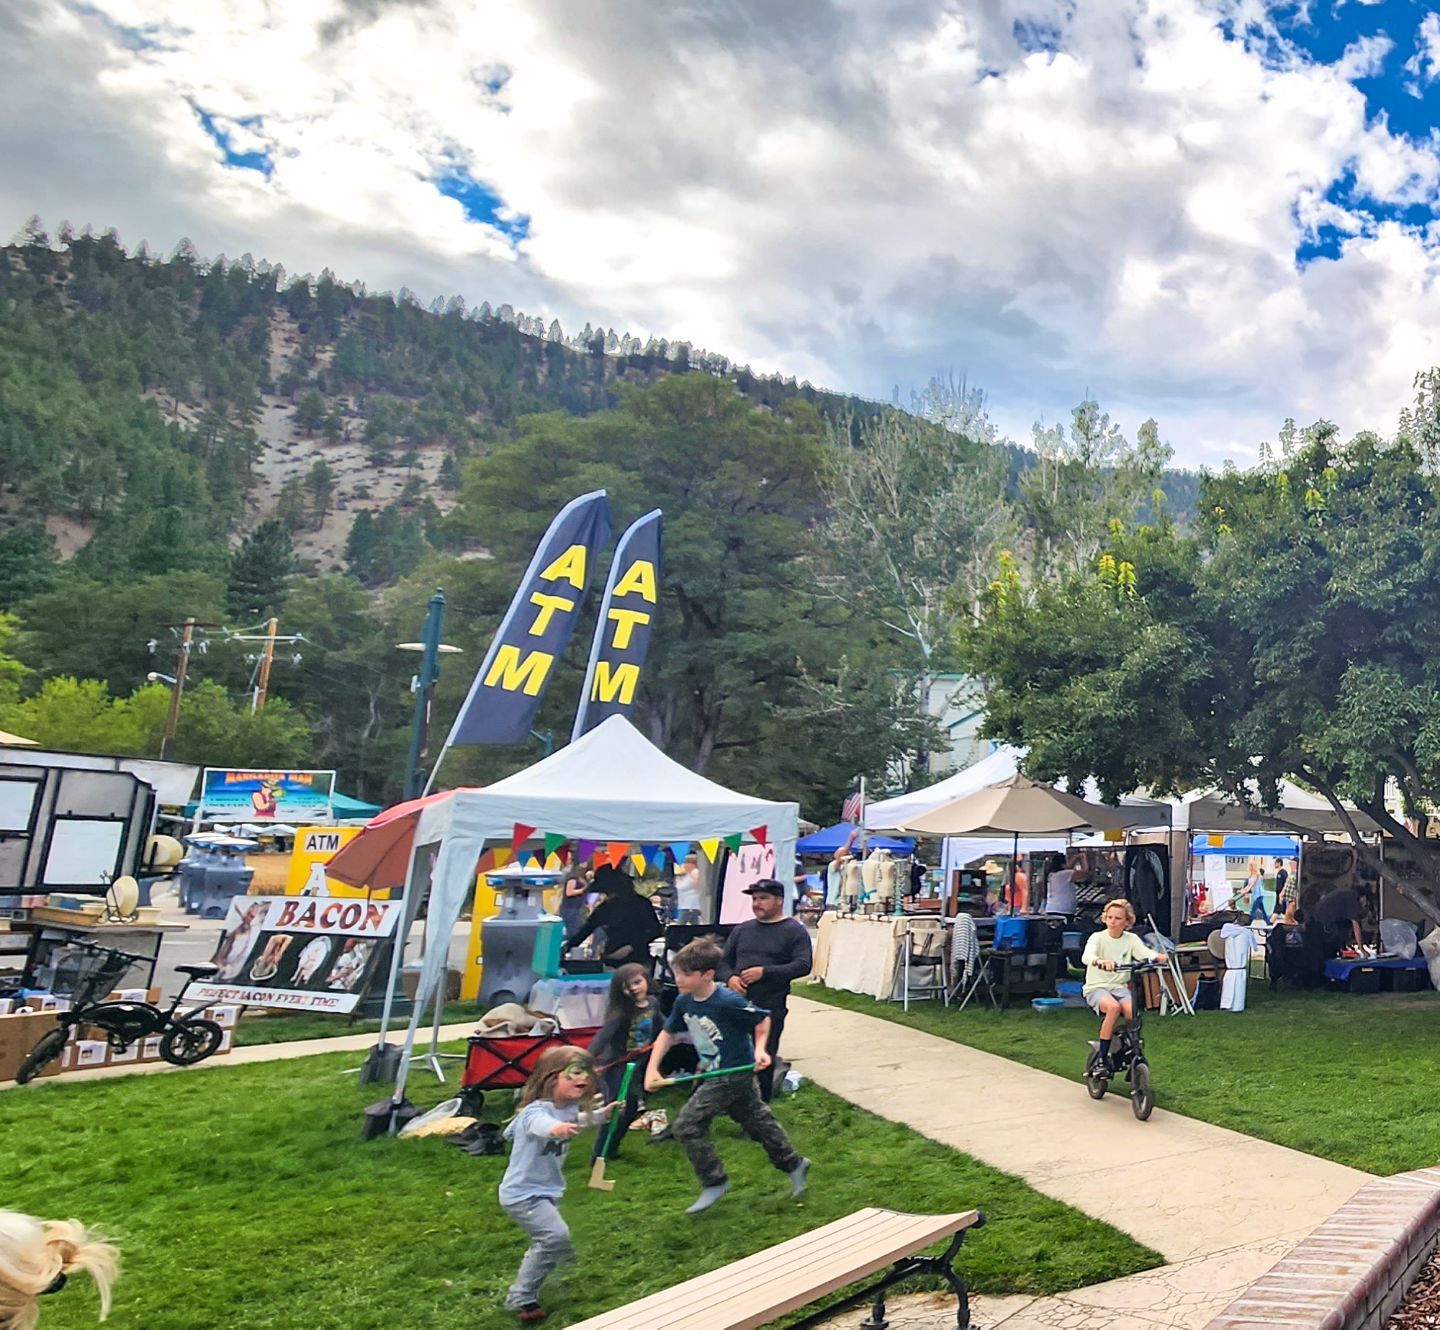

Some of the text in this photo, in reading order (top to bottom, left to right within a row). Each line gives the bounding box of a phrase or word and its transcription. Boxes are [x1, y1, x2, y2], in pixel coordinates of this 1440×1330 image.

[484, 544, 587, 697] ATM
[590, 559, 657, 705] ATM
[288, 772, 313, 785] MAN
[306, 834, 339, 851] ATM
[275, 901, 390, 931] BACON
[198, 987, 240, 1000] PERFECT
[275, 993, 308, 1005] EVERY
[311, 996, 340, 1007] TIME
